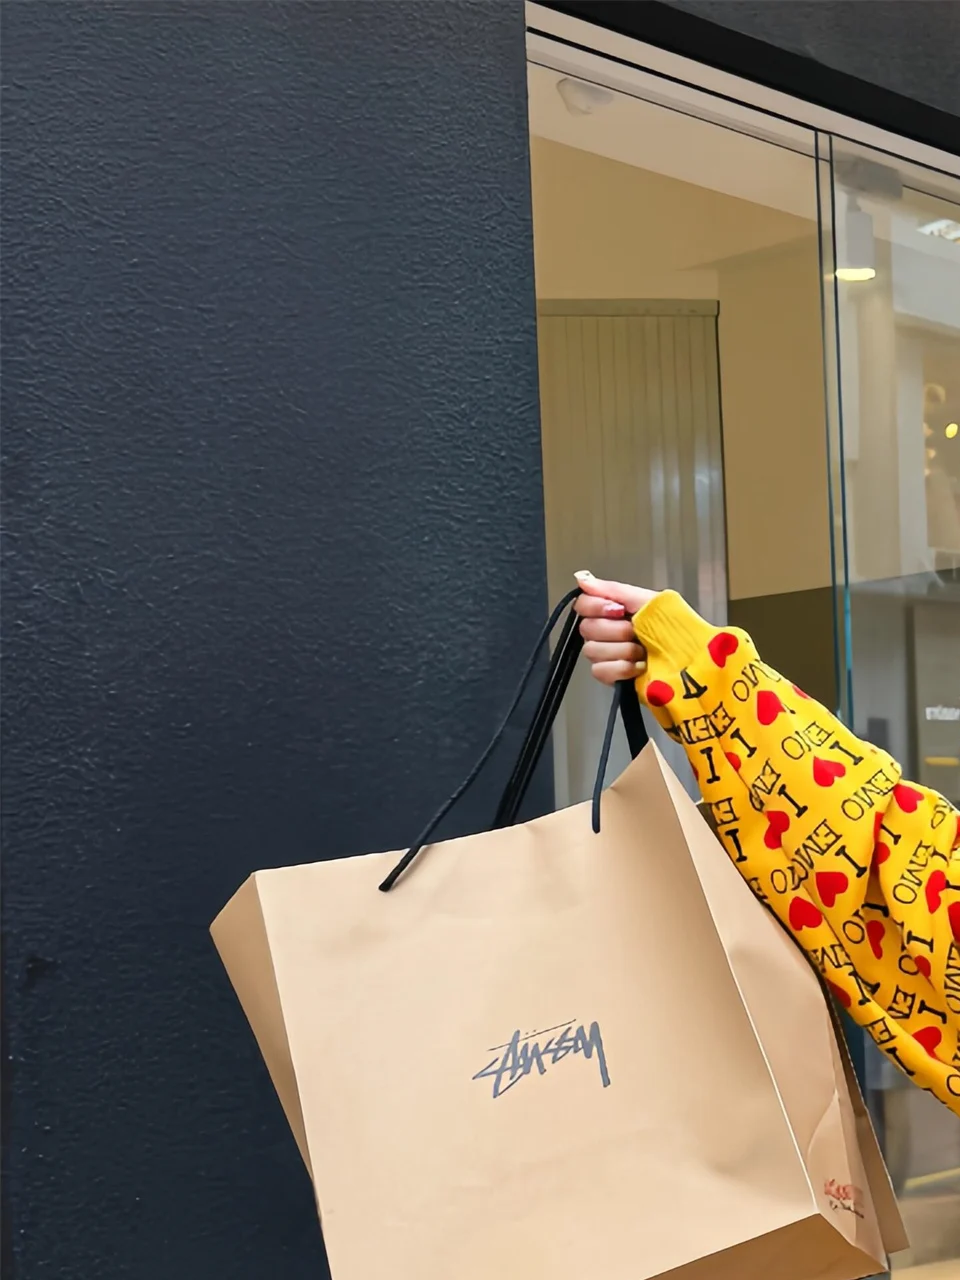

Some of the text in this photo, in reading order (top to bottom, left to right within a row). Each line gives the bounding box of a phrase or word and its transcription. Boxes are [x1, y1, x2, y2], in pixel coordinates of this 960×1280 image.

[730, 728, 757, 758] I
[829, 741, 864, 765] I
[700, 747, 720, 784] I
[777, 784, 808, 818] I
[841, 769, 897, 821] EMO
[835, 845, 867, 878] I
[906, 930, 934, 953] I
[917, 1000, 947, 1024] I
[885, 1047, 915, 1076] I
